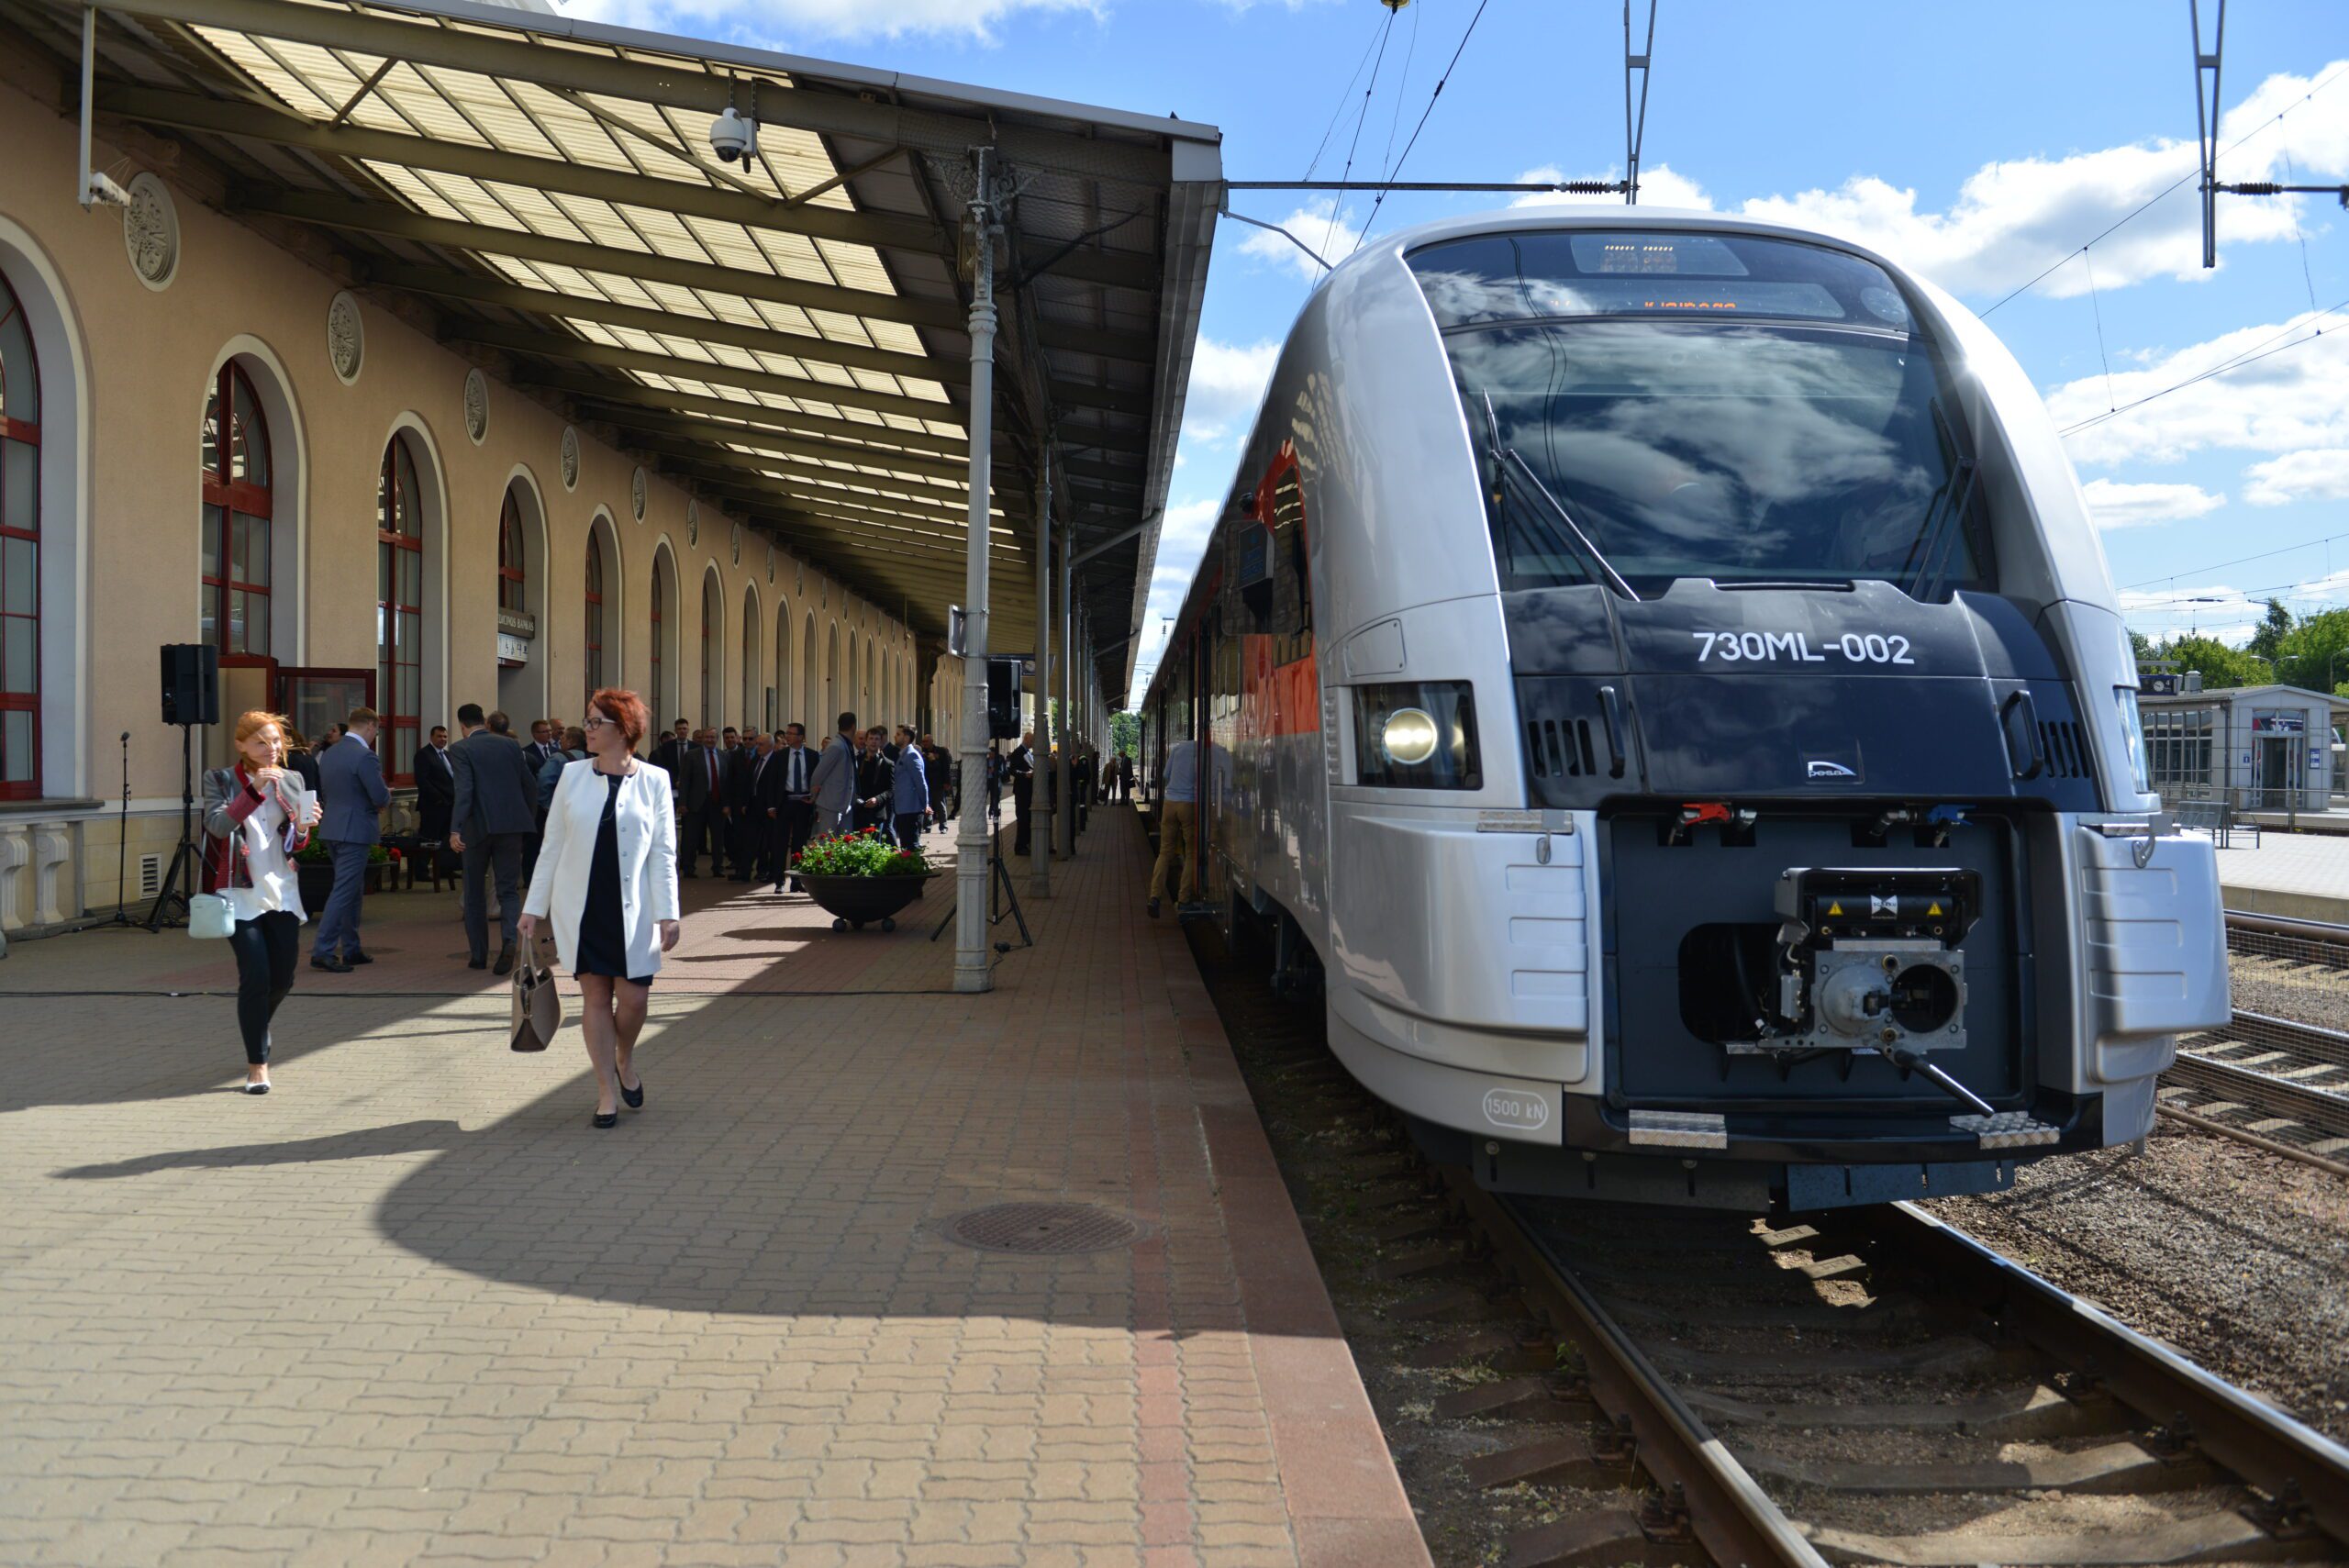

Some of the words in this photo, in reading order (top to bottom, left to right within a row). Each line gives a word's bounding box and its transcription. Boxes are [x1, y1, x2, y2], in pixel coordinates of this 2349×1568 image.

[1693, 631, 1915, 664] 730ML-002
[1487, 1097, 1520, 1117] 1500
[1526, 1103, 1543, 1120] kN
